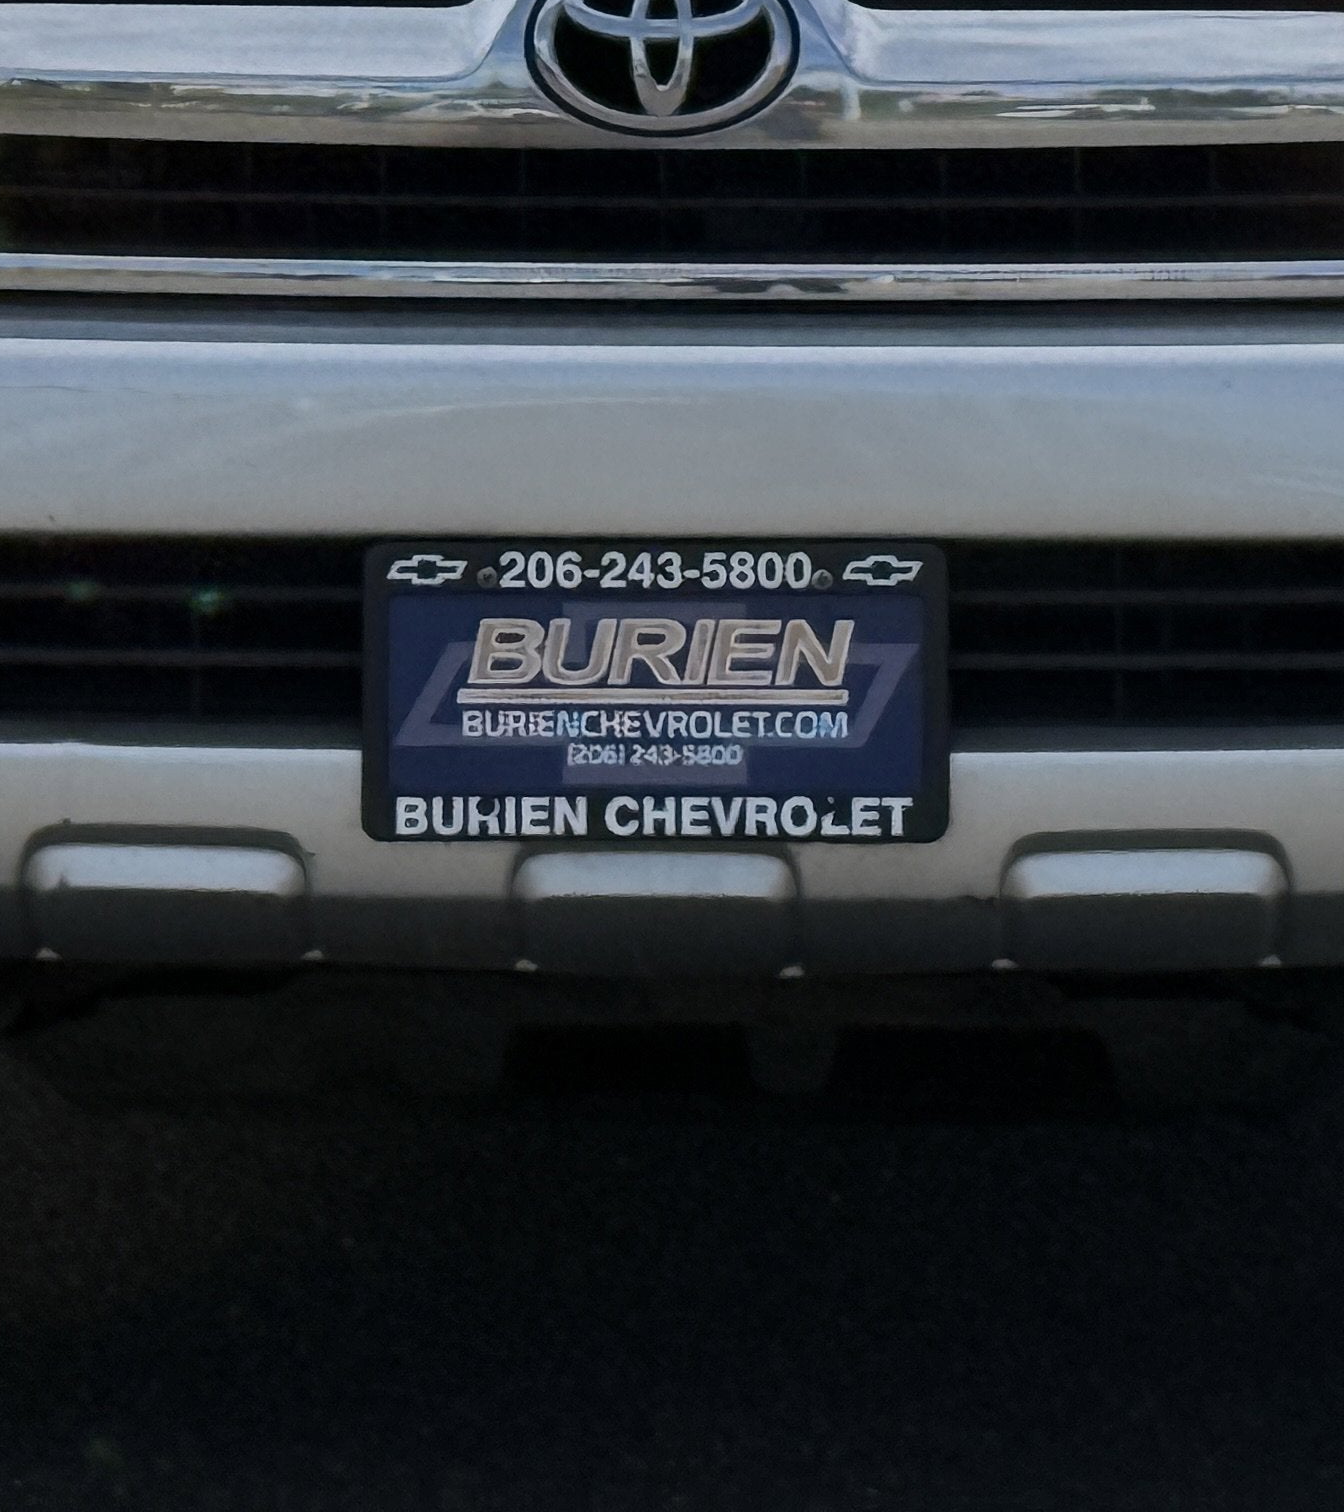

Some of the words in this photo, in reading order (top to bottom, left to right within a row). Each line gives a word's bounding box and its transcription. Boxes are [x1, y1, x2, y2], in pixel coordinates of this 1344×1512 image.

[499, 551, 812, 589] 206-243-5800
[467, 618, 855, 686] BURIEN
[461, 710, 849, 739] BURIENCHEVROLET.COM
